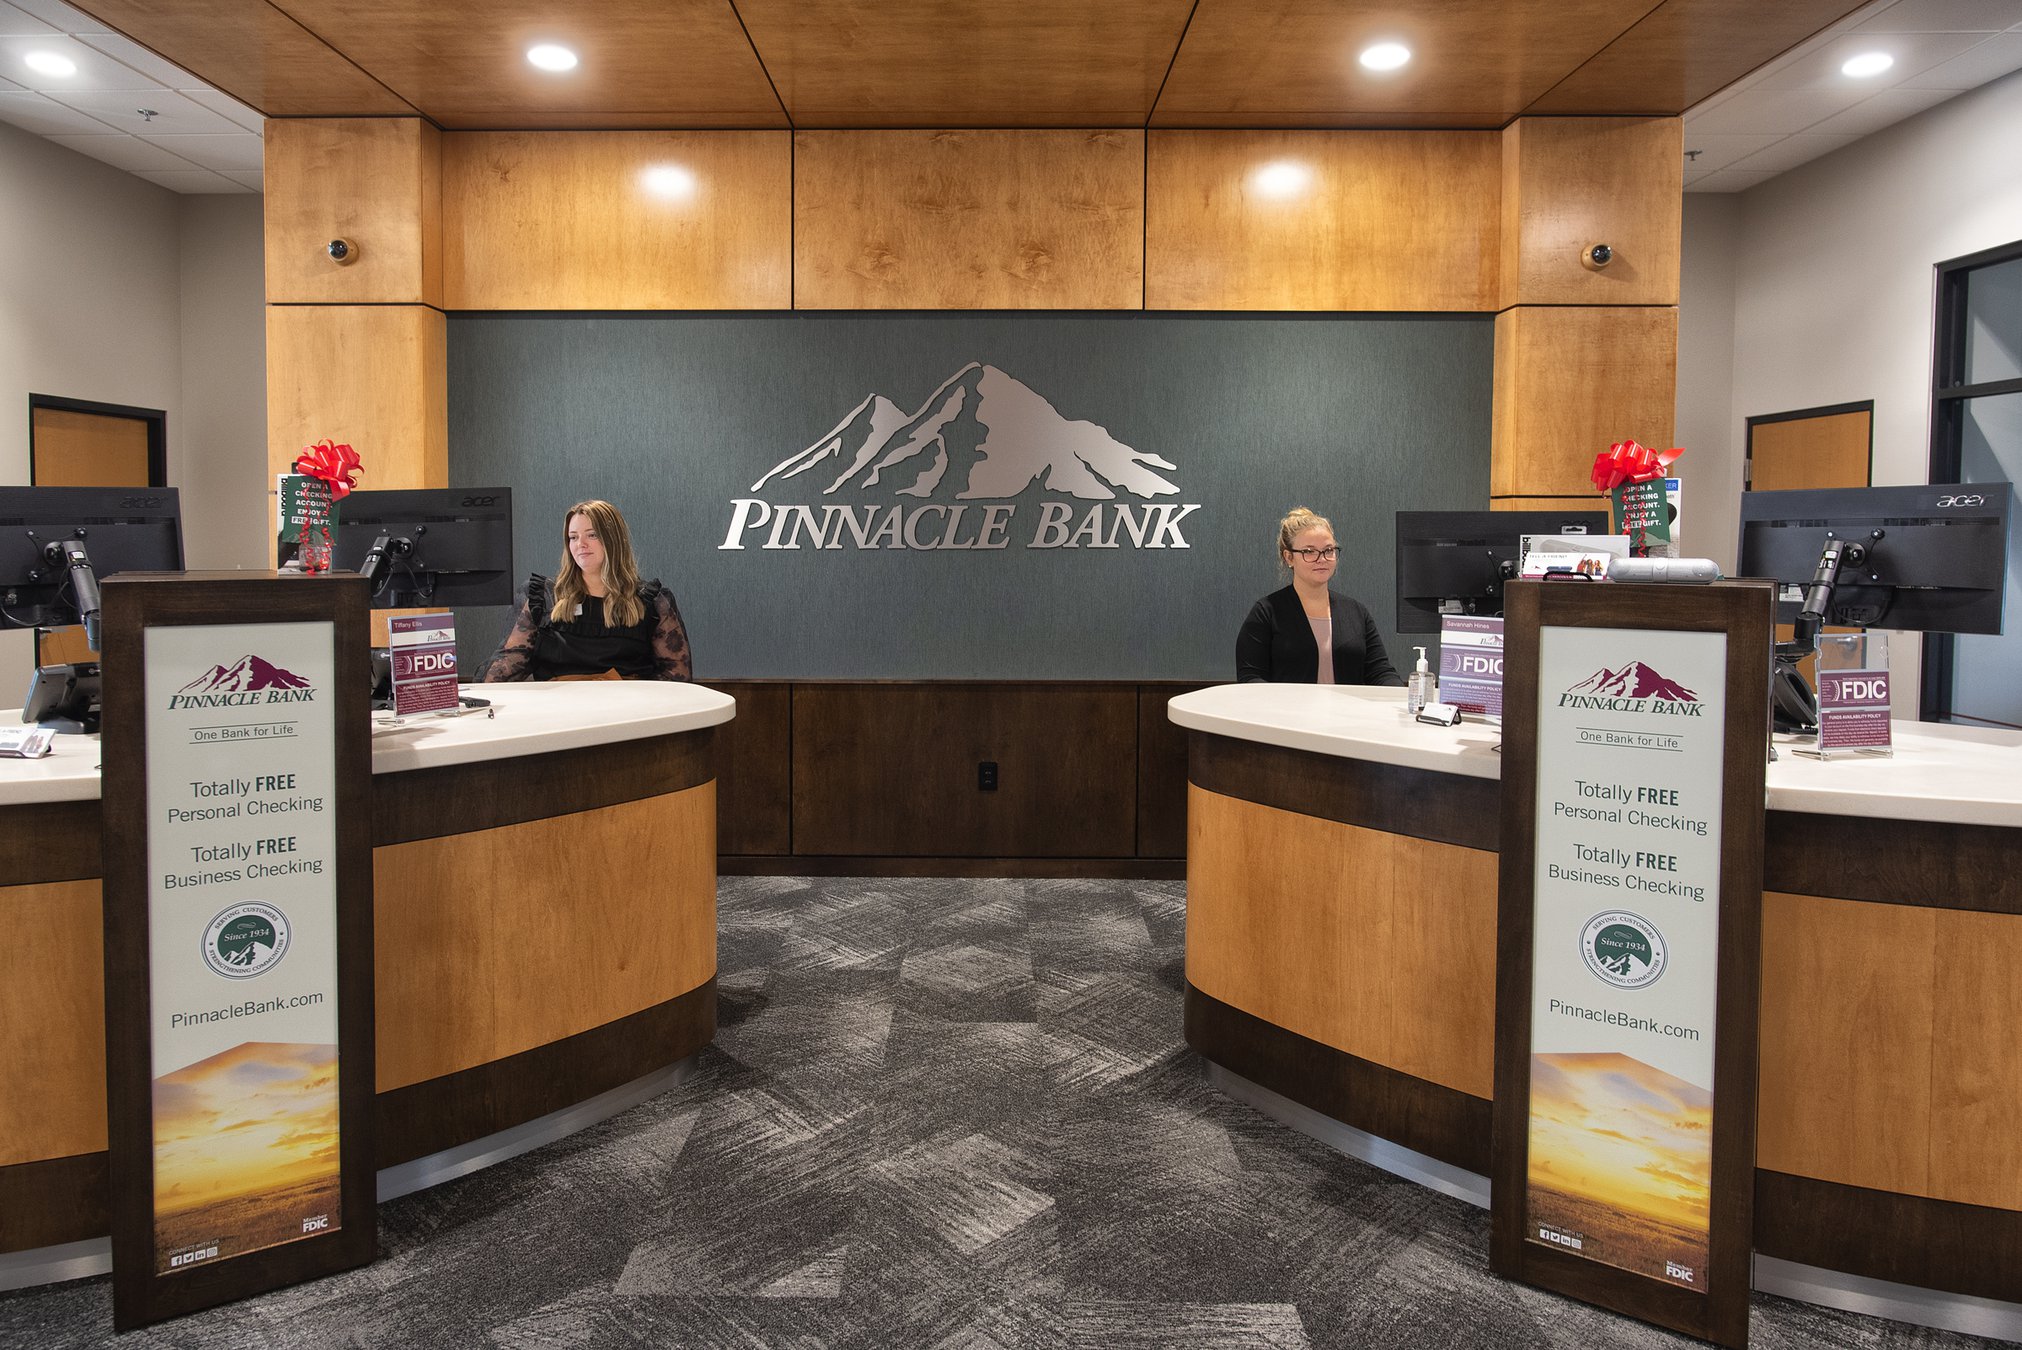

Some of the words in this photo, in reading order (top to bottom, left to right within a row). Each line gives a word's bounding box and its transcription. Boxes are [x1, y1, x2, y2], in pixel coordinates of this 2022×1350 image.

[461, 496, 501, 507] acer
[1624, 493, 1659, 501] HEKING
[1936, 494, 1994, 508] acer
[717, 498, 1016, 551] PINNACLE
[1027, 501, 1202, 550] BANK
[1446, 620, 1473, 629] Savannah
[1474, 622, 1490, 630] Hines
[414, 652, 454, 672] FDIC
[1463, 656, 1503, 675] FDIC
[168, 691, 262, 710] PINNACLE
[267, 688, 318, 704] BANK
[1842, 680, 1887, 700] FDIC
[1557, 692, 1646, 713] PINNACLE
[1651, 700, 1705, 717] BANK
[194, 730, 217, 741] One
[222, 726, 250, 739] Bank
[254, 726, 269, 736] for
[273, 725, 294, 735] Life
[1580, 731, 1602, 742] One
[1606, 732, 1634, 745] Bank
[1637, 735, 1653, 746] for
[1656, 737, 1679, 748] Life
[190, 778, 251, 798] Totally
[255, 774, 296, 792] FREE
[1574, 780, 1632, 805] Totally
[1637, 787, 1679, 806] FREE
[168, 803, 241, 824] Personal
[247, 796, 324, 816] Checking
[1554, 802, 1622, 823] Personal
[1628, 810, 1708, 836] Checking
[191, 842, 252, 863] Totally
[256, 836, 297, 856] FREE
[1573, 843, 1631, 869] Totally
[1636, 851, 1678, 872] FREE
[164, 869, 242, 889] Business
[246, 859, 323, 879] Checking
[1549, 863, 1620, 887] Business
[1625, 874, 1705, 902] Checking
[214, 909, 241, 930] SERVING
[242, 907, 279, 922] CUSTOMERS
[1592, 916, 1617, 931] SERVING
[1619, 916, 1656, 940] CUSTOMERS
[224, 932, 248, 942] Since
[249, 928, 270, 938] 1934
[1601, 937, 1624, 948] Since
[1625, 941, 1646, 952] 1934
[209, 949, 252, 974] STRENGTHENING
[252, 939, 284, 972] COMMUNITIES
[171, 992, 324, 1029] PinnacleBank.com
[1549, 998, 1700, 1041] PinnacleBank.com
[303, 1214, 328, 1223] Member
[303, 1218, 328, 1232] FDIC
[1666, 1260, 1693, 1272] Member
[1666, 1266, 1693, 1282] FDIC
